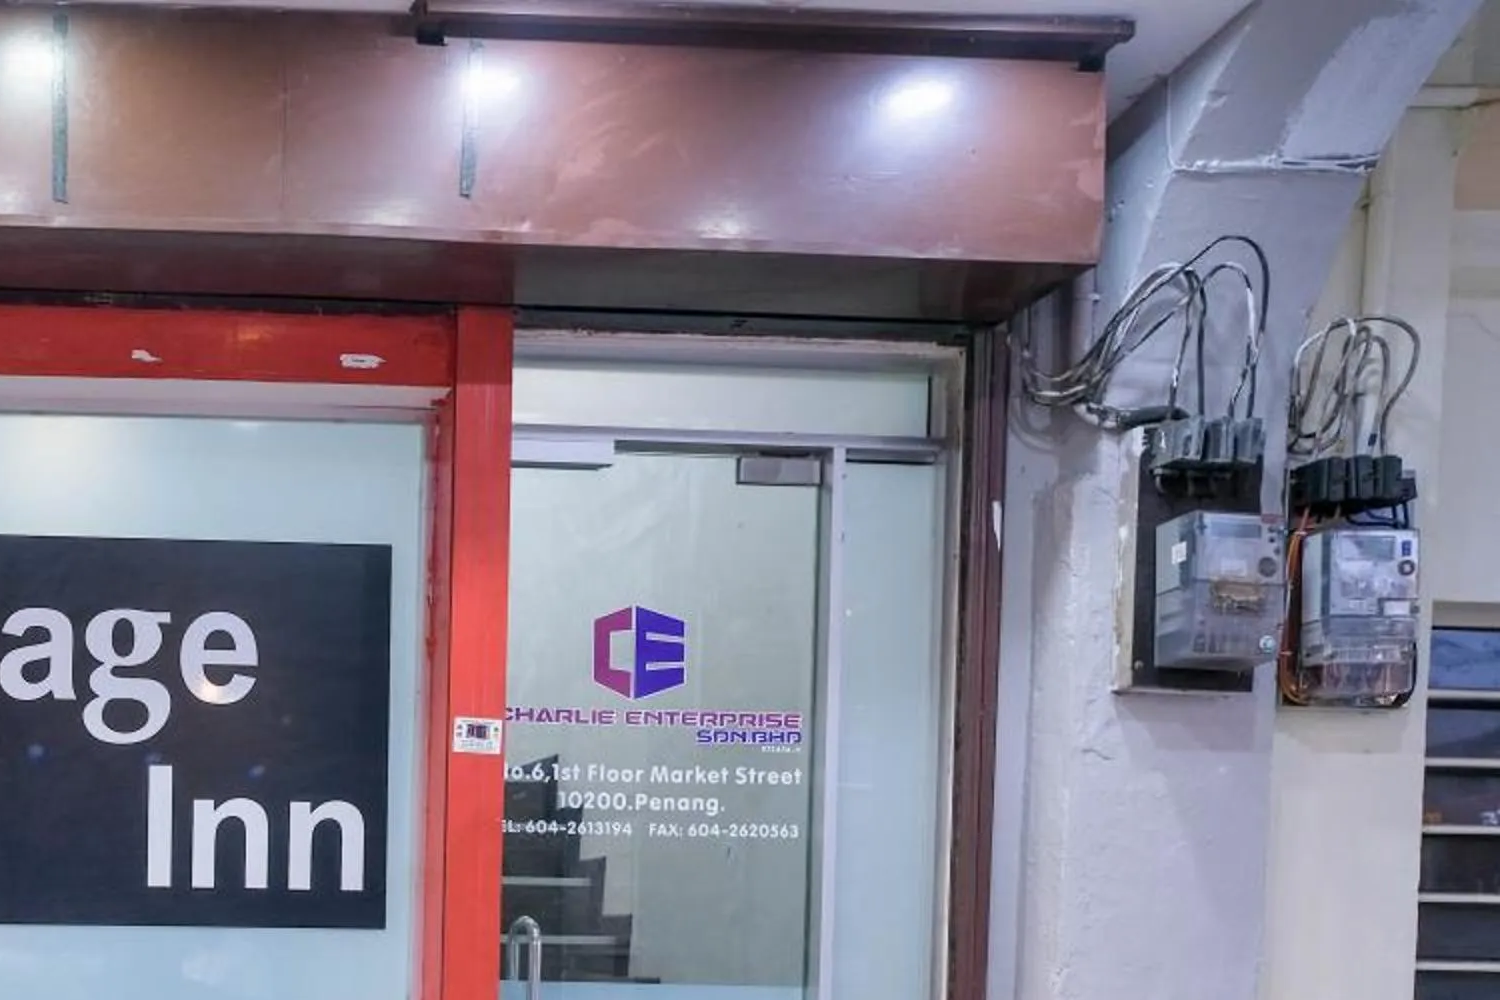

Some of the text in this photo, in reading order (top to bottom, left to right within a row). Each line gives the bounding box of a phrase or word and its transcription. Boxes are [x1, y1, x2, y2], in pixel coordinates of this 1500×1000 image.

[624, 710, 803, 729] ENTERPRISE
[587, 764, 645, 783] Floor
[650, 765, 729, 785] Market
[735, 767, 803, 785] Street
[146, 763, 366, 892] Inn
